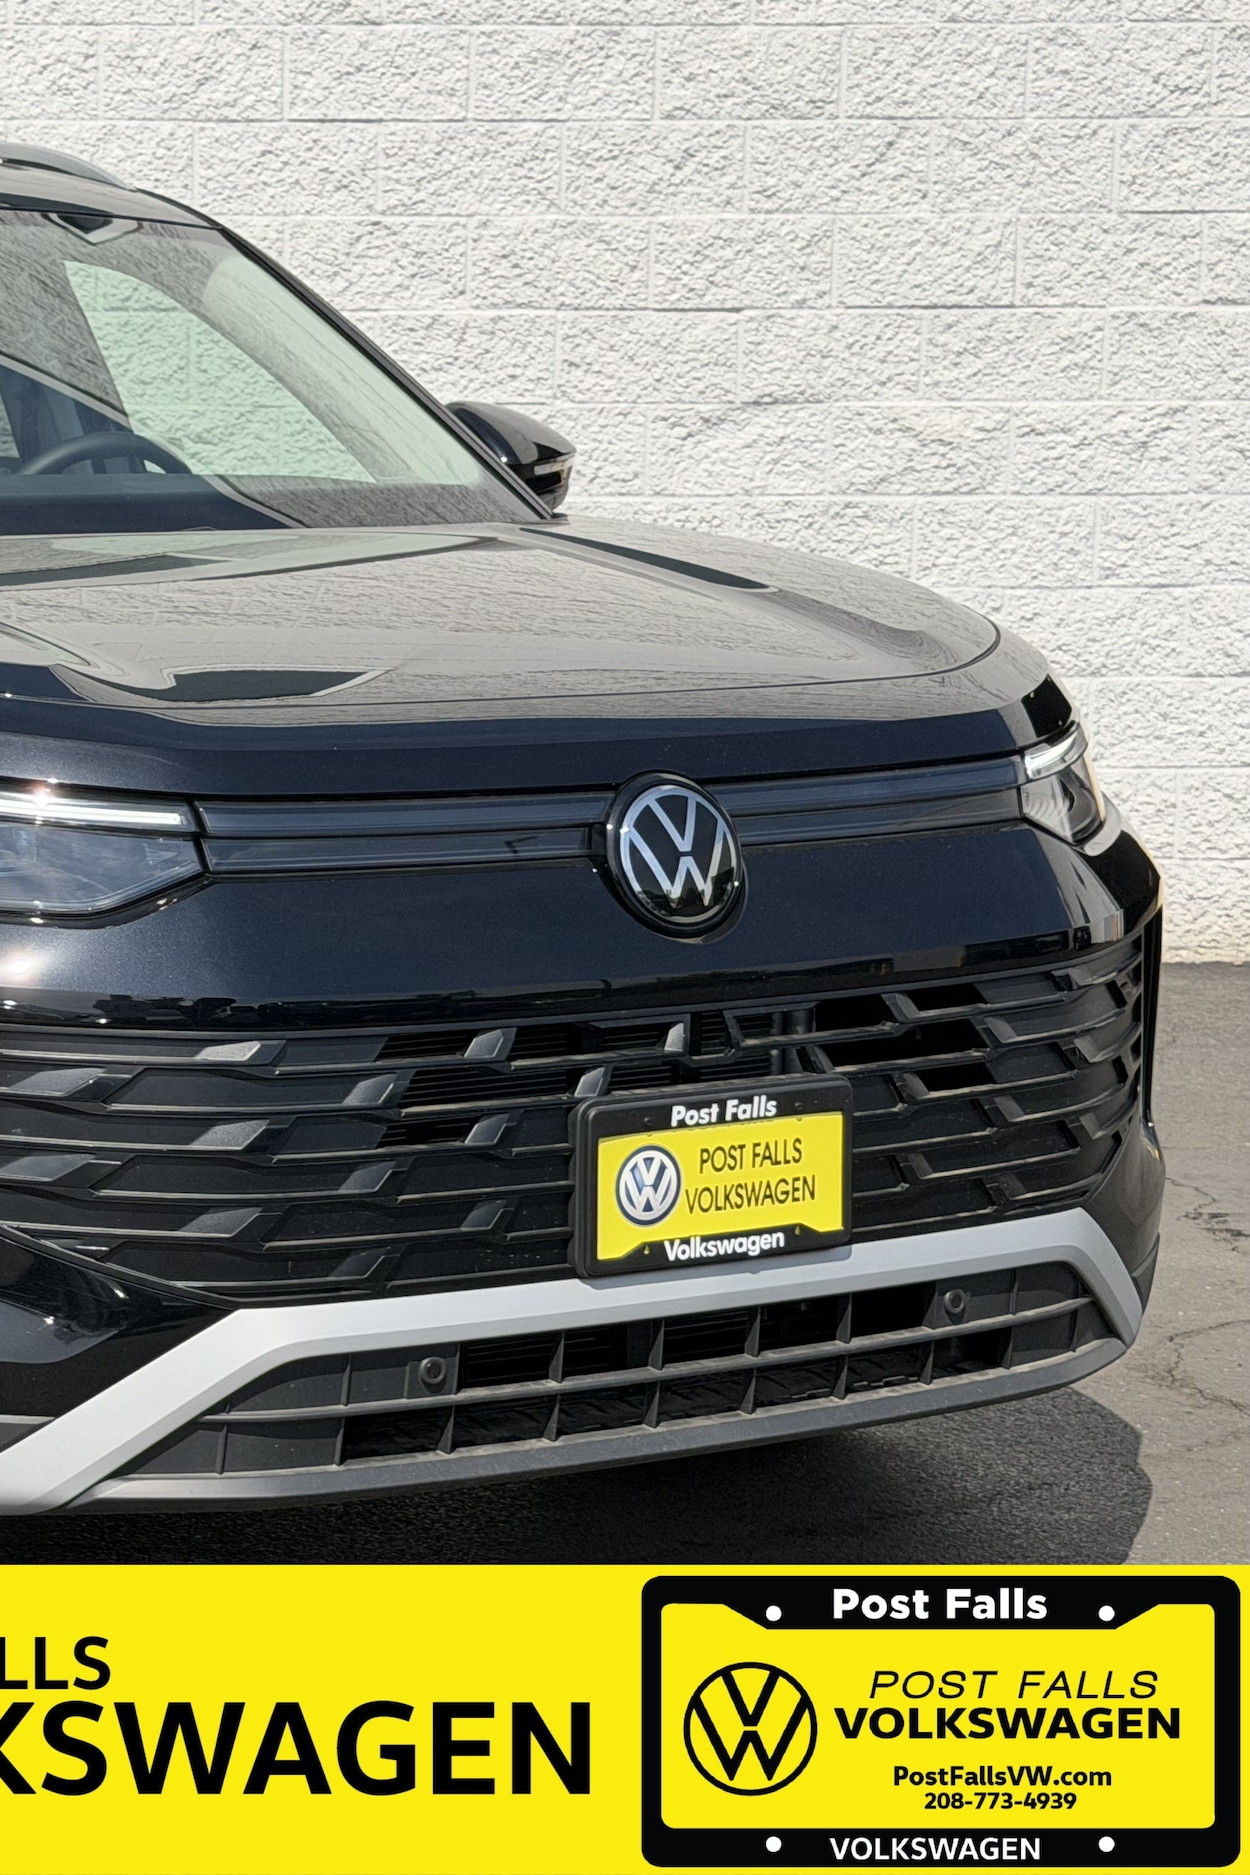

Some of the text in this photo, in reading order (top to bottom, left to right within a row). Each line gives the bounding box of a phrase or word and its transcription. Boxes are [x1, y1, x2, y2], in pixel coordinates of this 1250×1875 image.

[671, 1095, 777, 1127] Post Falls
[700, 1137, 802, 1174] POST FALLS
[685, 1174, 816, 1214] VOLKSWAGEN
[664, 1231, 785, 1262] Volkswagen
